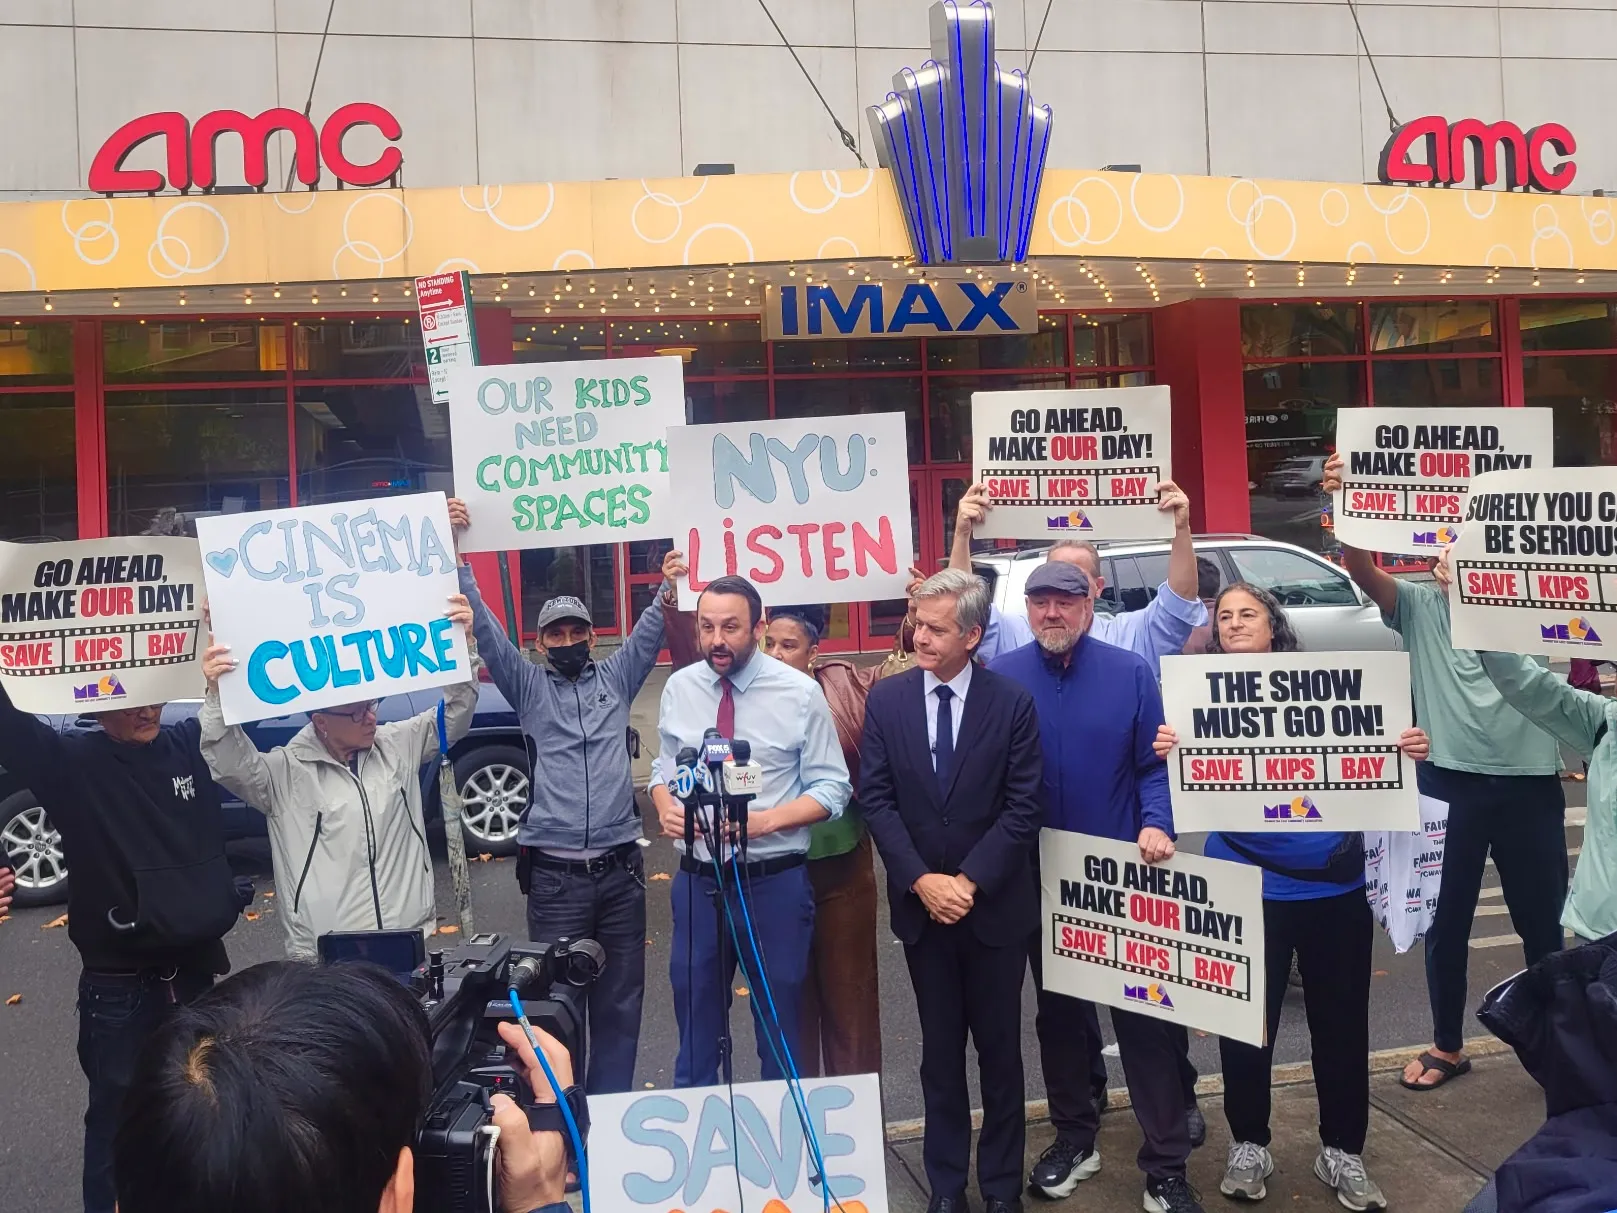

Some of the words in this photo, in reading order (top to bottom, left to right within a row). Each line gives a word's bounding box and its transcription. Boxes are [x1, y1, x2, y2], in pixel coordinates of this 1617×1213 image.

[88, 102, 403, 192] amc
[1380, 115, 1577, 191] amc
[418, 281, 427, 289] NO
[427, 275, 454, 287] STANDING
[420, 288, 443, 298] Anytime
[429, 348, 439, 364] 2
[477, 376, 553, 415] OUR
[575, 375, 651, 409] KIDS
[514, 412, 598, 450] NEED
[1011, 409, 1041, 434] GO
[1044, 406, 1128, 434] AHEAD,
[988, 436, 1048, 462] MAKE
[1050, 435, 1098, 461] OUR
[1101, 433, 1153, 460] DAY!
[1375, 424, 1410, 450] GO
[1413, 425, 1505, 453] AHEAD,
[476, 438, 669, 492] COMMUNITY
[713, 432, 878, 509] NYU:
[1350, 451, 1416, 477] MAKE
[1419, 452, 1471, 478] OUR
[988, 478, 1031, 499] SAVE
[1047, 477, 1089, 498] KIPS
[1111, 477, 1147, 498] BAY
[1351, 491, 1397, 512] SAVE
[1416, 494, 1460, 515] KIPS
[512, 484, 652, 532] SPACES
[1465, 492, 1540, 522] SURELY
[1543, 491, 1593, 522] YOU
[239, 507, 456, 582] CINEMA
[1484, 524, 1516, 554] BE
[1519, 524, 1617, 556] SERIOU
[33, 558, 74, 587] GO
[75, 554, 168, 585] AHEAD,
[1467, 571, 1518, 597] SAVE
[1538, 575, 1590, 600] KIPS
[1, 590, 77, 623] MAKE
[80, 586, 134, 618] OUR
[138, 583, 194, 614] DAY!
[303, 573, 366, 628] IS
[0, 642, 53, 667] SAVE
[74, 637, 123, 662] KIPS
[147, 632, 187, 656] BAY
[247, 617, 458, 704] CULTURE
[1205, 671, 1262, 703] THE
[1269, 668, 1363, 702] SHOW
[1192, 706, 1277, 739] MUST
[1283, 705, 1326, 737] GO
[1331, 704, 1385, 737] ON!
[1191, 758, 1244, 782] SAVE
[1265, 758, 1315, 781] KIPS
[1341, 757, 1385, 780] BAY
[1084, 854, 1119, 884] GO
[1123, 860, 1214, 908] AHEAD,
[1060, 879, 1126, 920] MAKE
[1129, 893, 1181, 932] OUR
[1184, 906, 1243, 945] DAY!
[1061, 926, 1108, 956] SAVE
[1125, 940, 1171, 971] KIPS
[1194, 957, 1236, 986] BAY
[621, 1085, 866, 1206] SAVE
